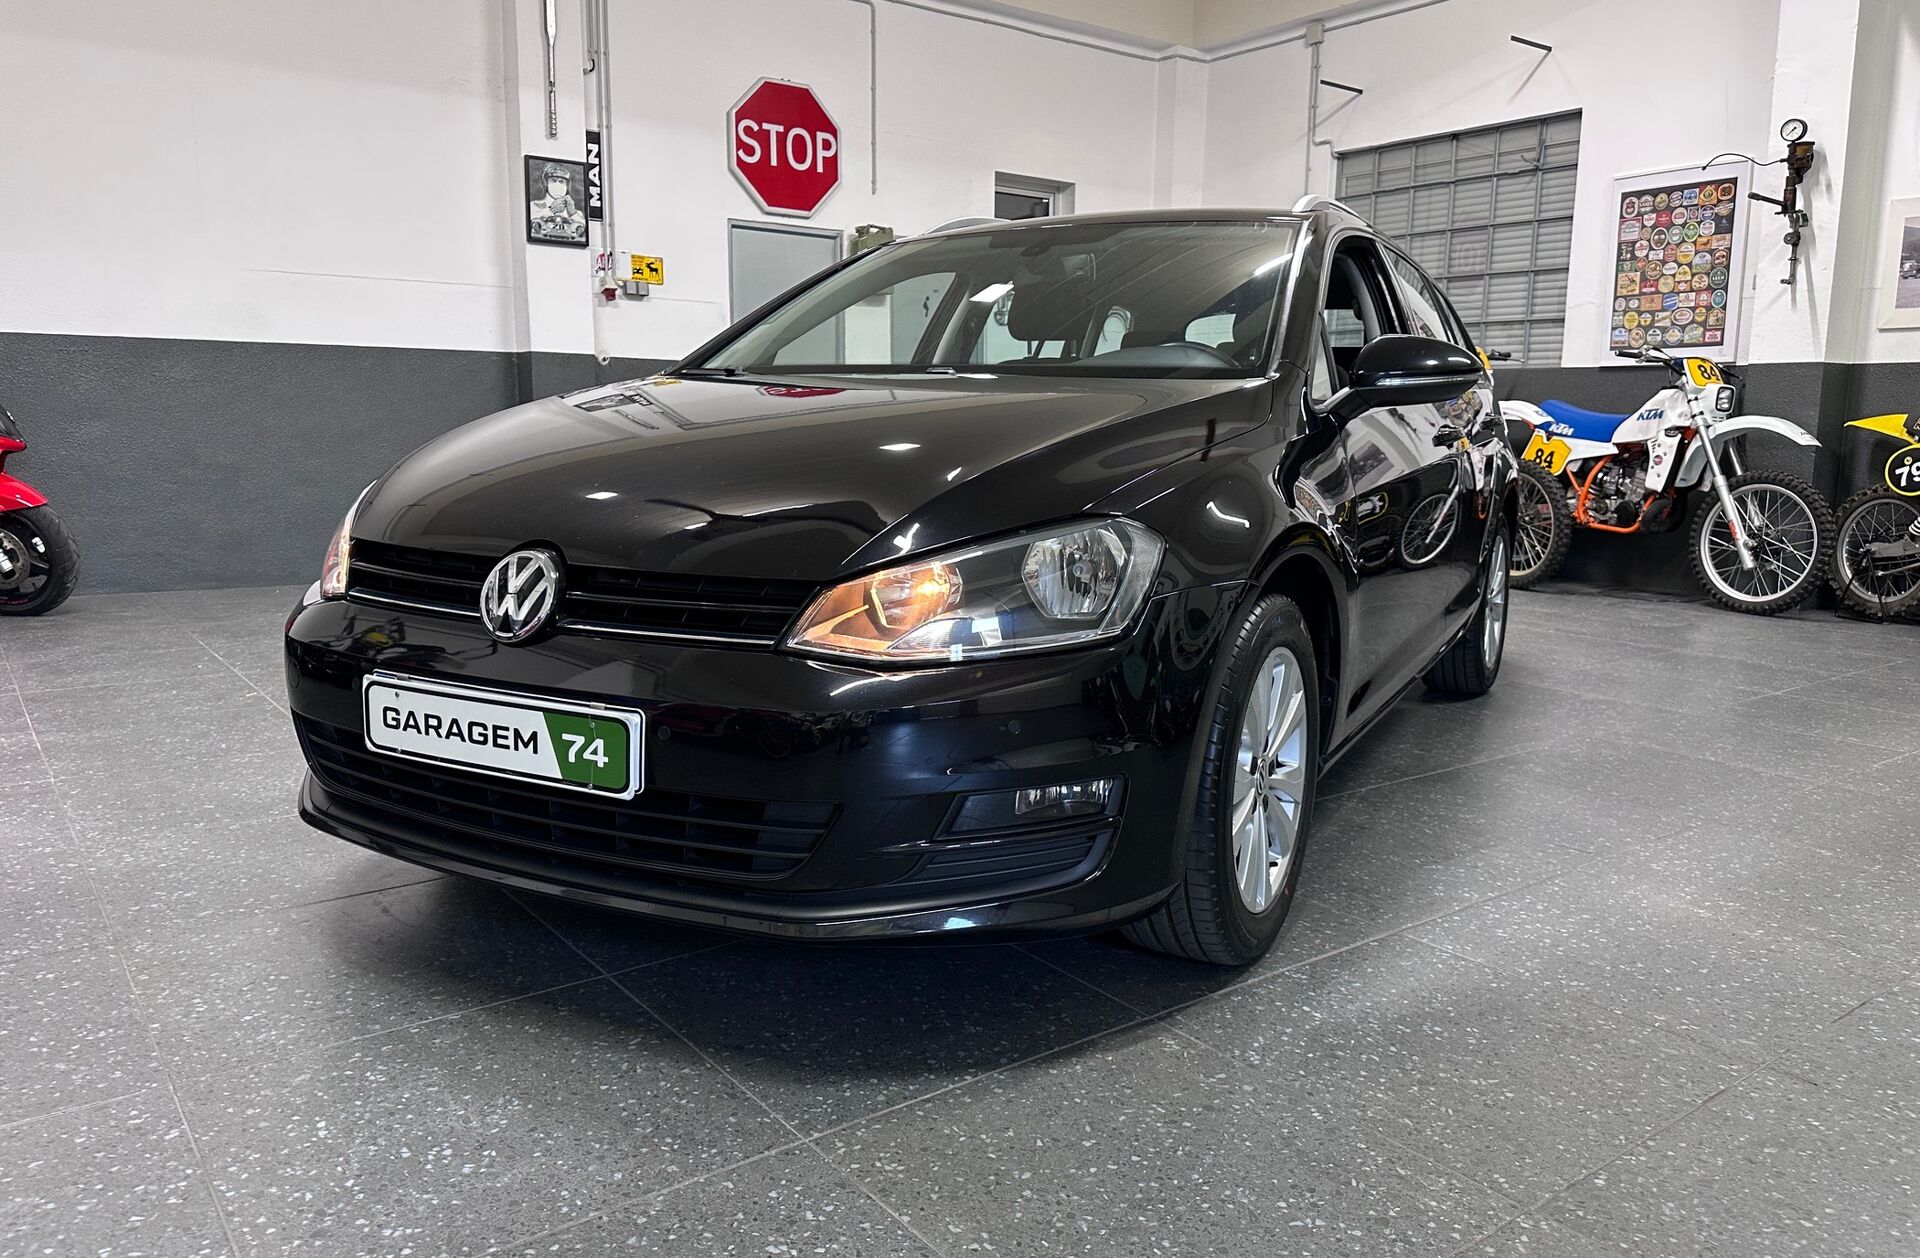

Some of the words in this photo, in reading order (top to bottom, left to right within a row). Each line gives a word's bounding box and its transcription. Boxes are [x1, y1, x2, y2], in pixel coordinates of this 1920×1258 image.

[737, 118, 837, 173] STOP
[587, 142, 602, 207] MAN
[1697, 363, 1722, 381] 84
[1636, 408, 1665, 421] KTM
[1548, 422, 1575, 436] KTM
[1532, 447, 1556, 469] 84
[382, 705, 539, 755] GARAGEM
[561, 732, 609, 768] 74
